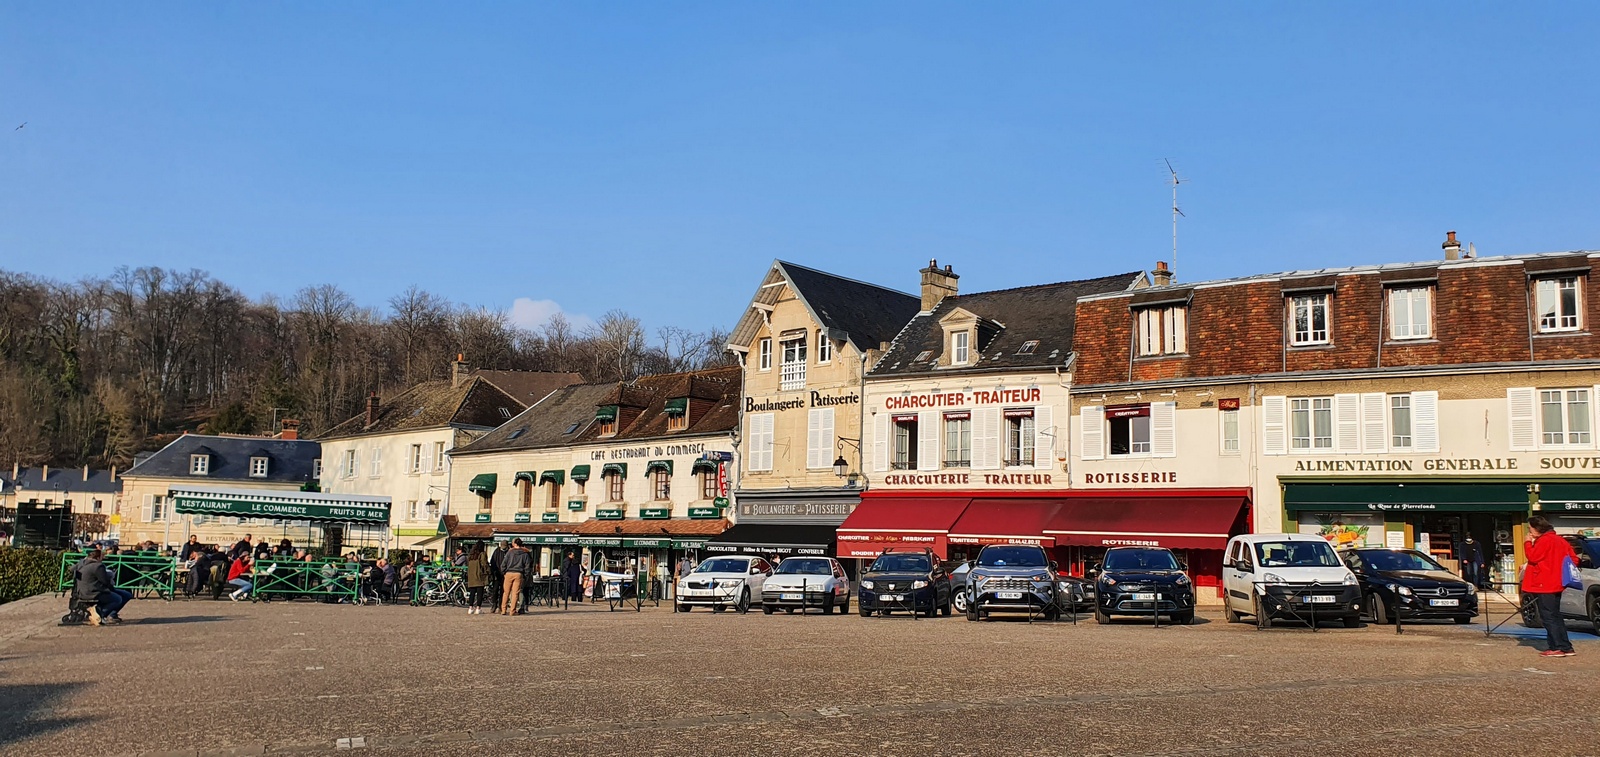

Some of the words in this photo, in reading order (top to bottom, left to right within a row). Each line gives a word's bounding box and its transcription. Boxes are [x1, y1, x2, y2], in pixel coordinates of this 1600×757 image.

[745, 396, 805, 412] Boulangerie
[810, 390, 860, 408] Patisserie
[610, 446, 650, 460] RESTAURANT
[654, 446, 664, 457] DU
[666, 443, 705, 456] COMMERCE
[1295, 460, 1412, 472] ALIMENTATION
[1424, 458, 1518, 471] GÉNÉRALE
[885, 474, 969, 485] CHARCUTERIE
[984, 474, 1052, 485] TRAITEUR
[1085, 472, 1177, 484] ROTISSERIE
[181, 500, 232, 510] RESTAURANT
[263, 504, 306, 514] COMMERCE
[752, 504, 796, 515] BOULANGERIE
[806, 503, 846, 516] PATISSERIE
[330, 508, 354, 516] FRUITS
[356, 509, 366, 517] DE
[368, 510, 384, 518] MER
